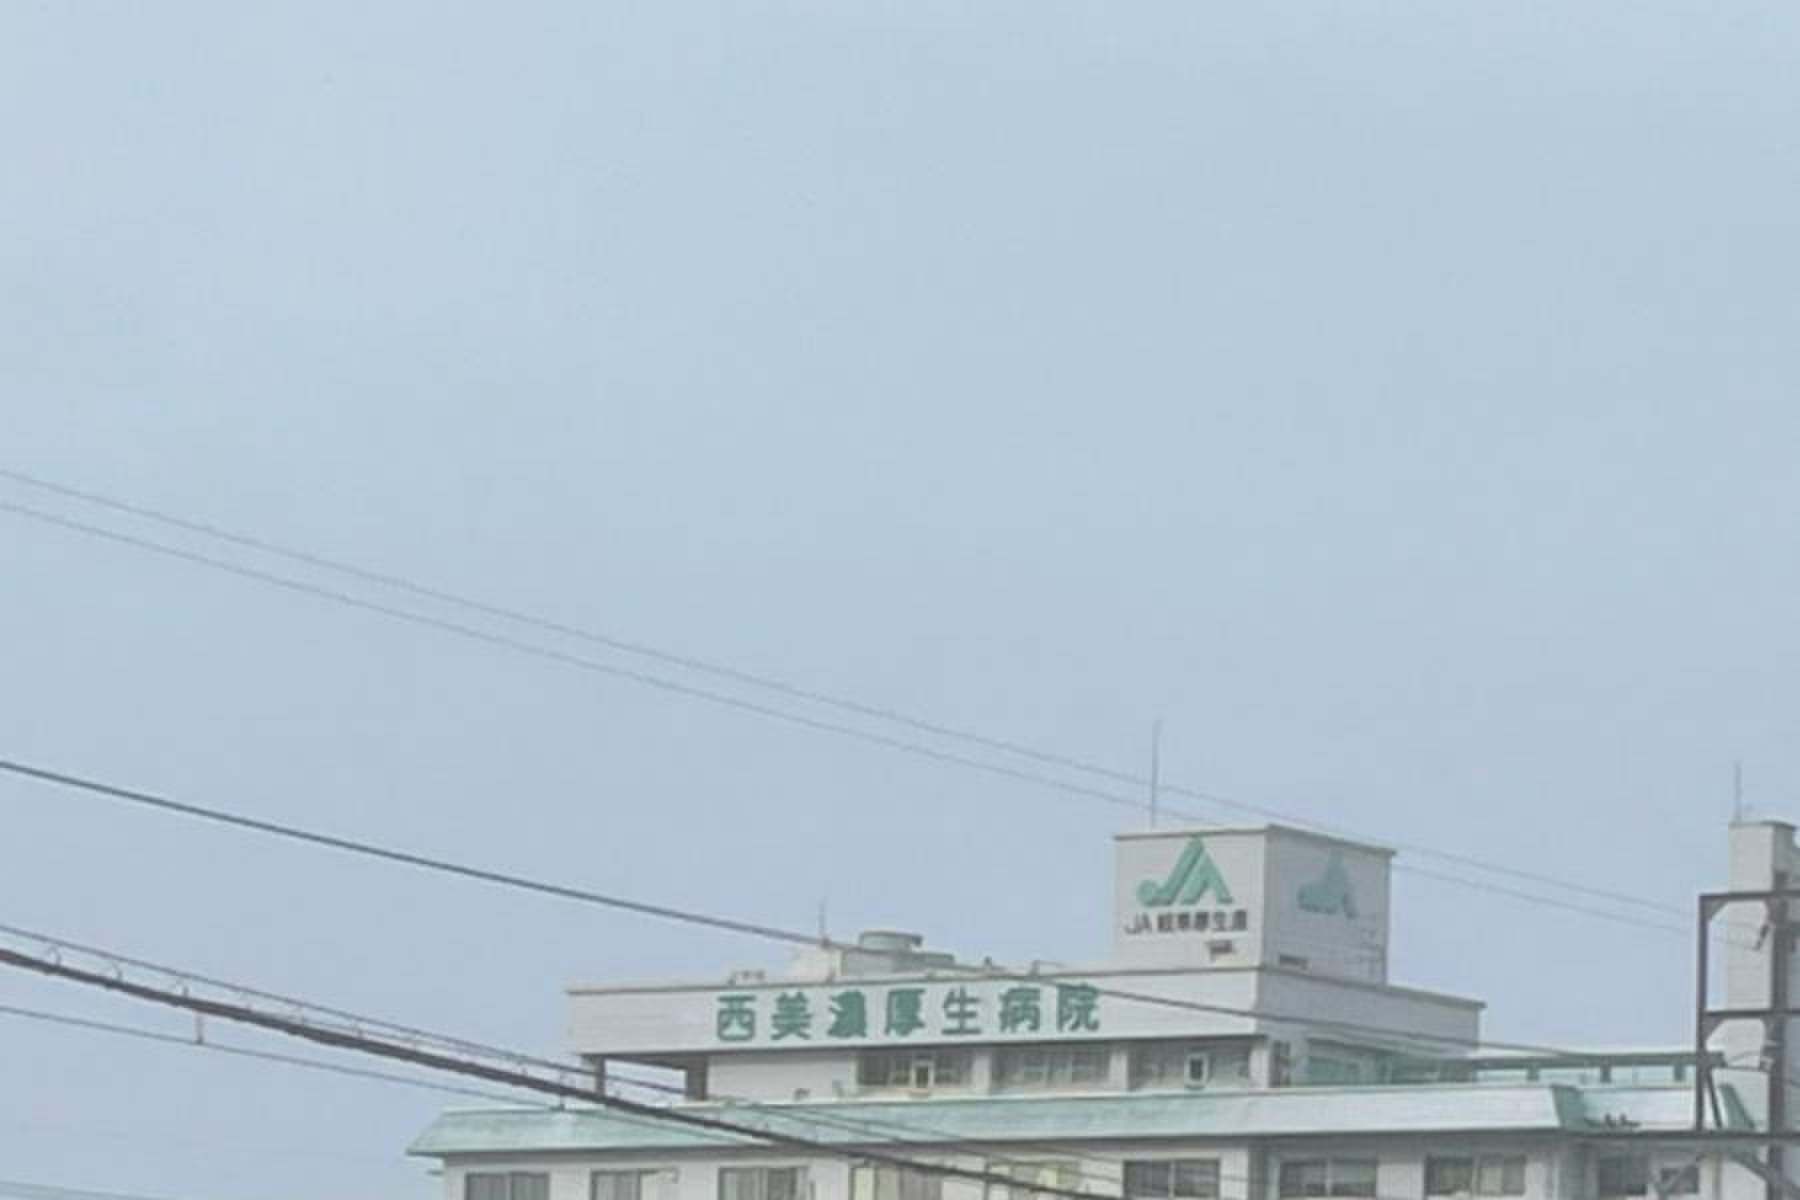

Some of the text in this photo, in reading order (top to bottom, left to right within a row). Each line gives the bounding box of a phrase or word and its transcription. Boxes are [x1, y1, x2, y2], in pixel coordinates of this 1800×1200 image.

[716, 983, 1100, 1042] 西美濃厚生病院
